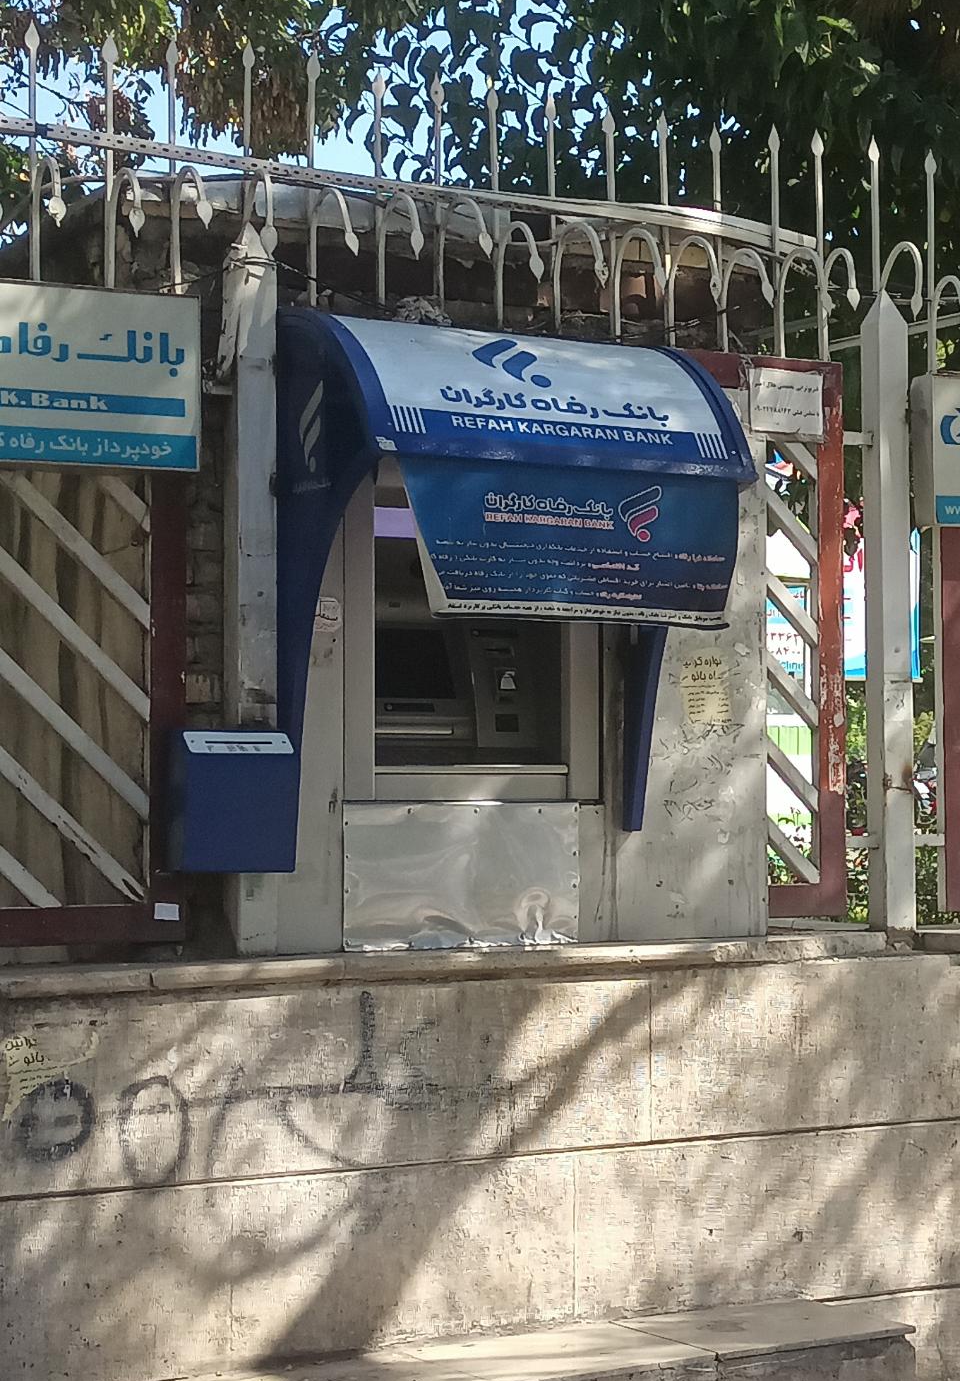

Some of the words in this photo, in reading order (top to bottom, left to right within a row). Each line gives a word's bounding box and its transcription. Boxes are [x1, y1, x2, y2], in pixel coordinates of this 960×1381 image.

[77, 329, 185, 378] بانک
[440, 385, 526, 410] کارگران
[531, 394, 599, 419] رفاه
[603, 402, 671, 427] بانک
[451, 415, 514, 433] REFAH
[517, 420, 619, 441] KARGARAN
[623, 429, 674, 446] BANK
[9, 432, 45, 453] رفاه
[50, 435, 88, 456] بانک
[93, 438, 172, 461] خودپرداز
[484, 492, 535, 511] کارگران
[536, 496, 572, 516] رفاه
[573, 499, 613, 521] بانک
[485, 512, 524, 523] REFAH
[524, 514, 583, 528] KARGARAN
[583, 519, 614, 529] BANK
